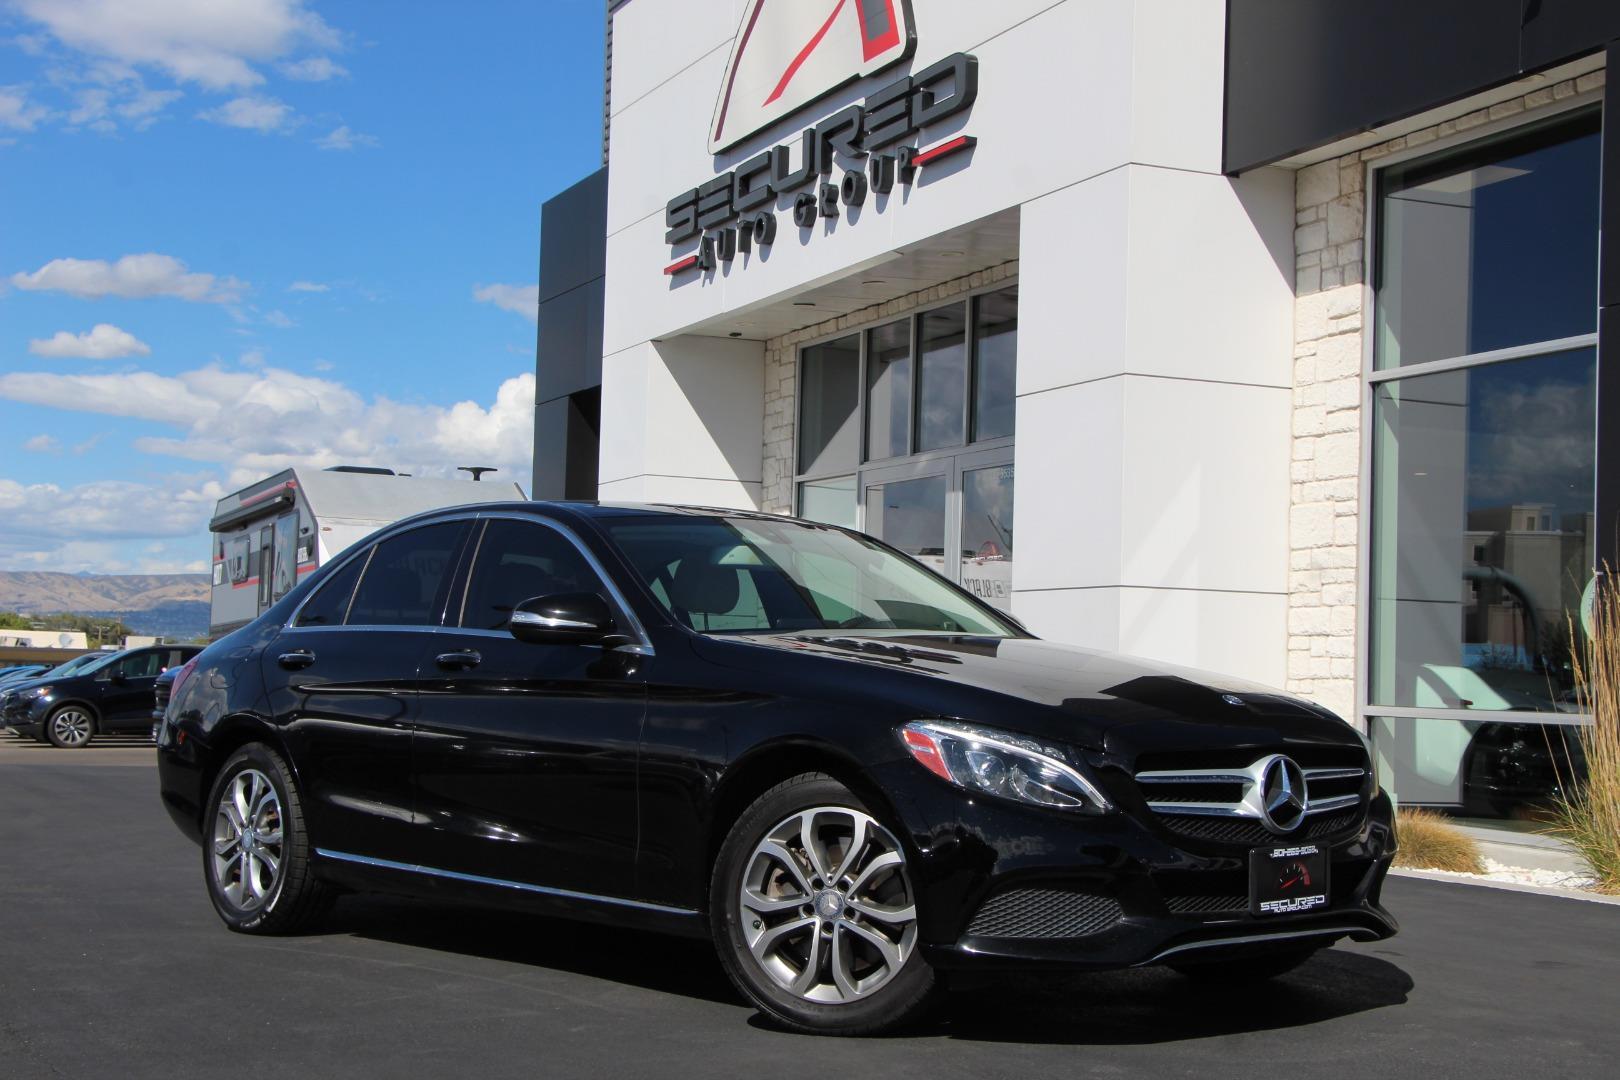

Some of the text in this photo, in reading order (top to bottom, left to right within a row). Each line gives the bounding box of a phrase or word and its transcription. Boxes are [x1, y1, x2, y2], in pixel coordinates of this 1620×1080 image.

[665, 52, 978, 244] SECURED
[696, 146, 918, 271] AUTO GROUP
[1260, 895, 1325, 911] SECURED
